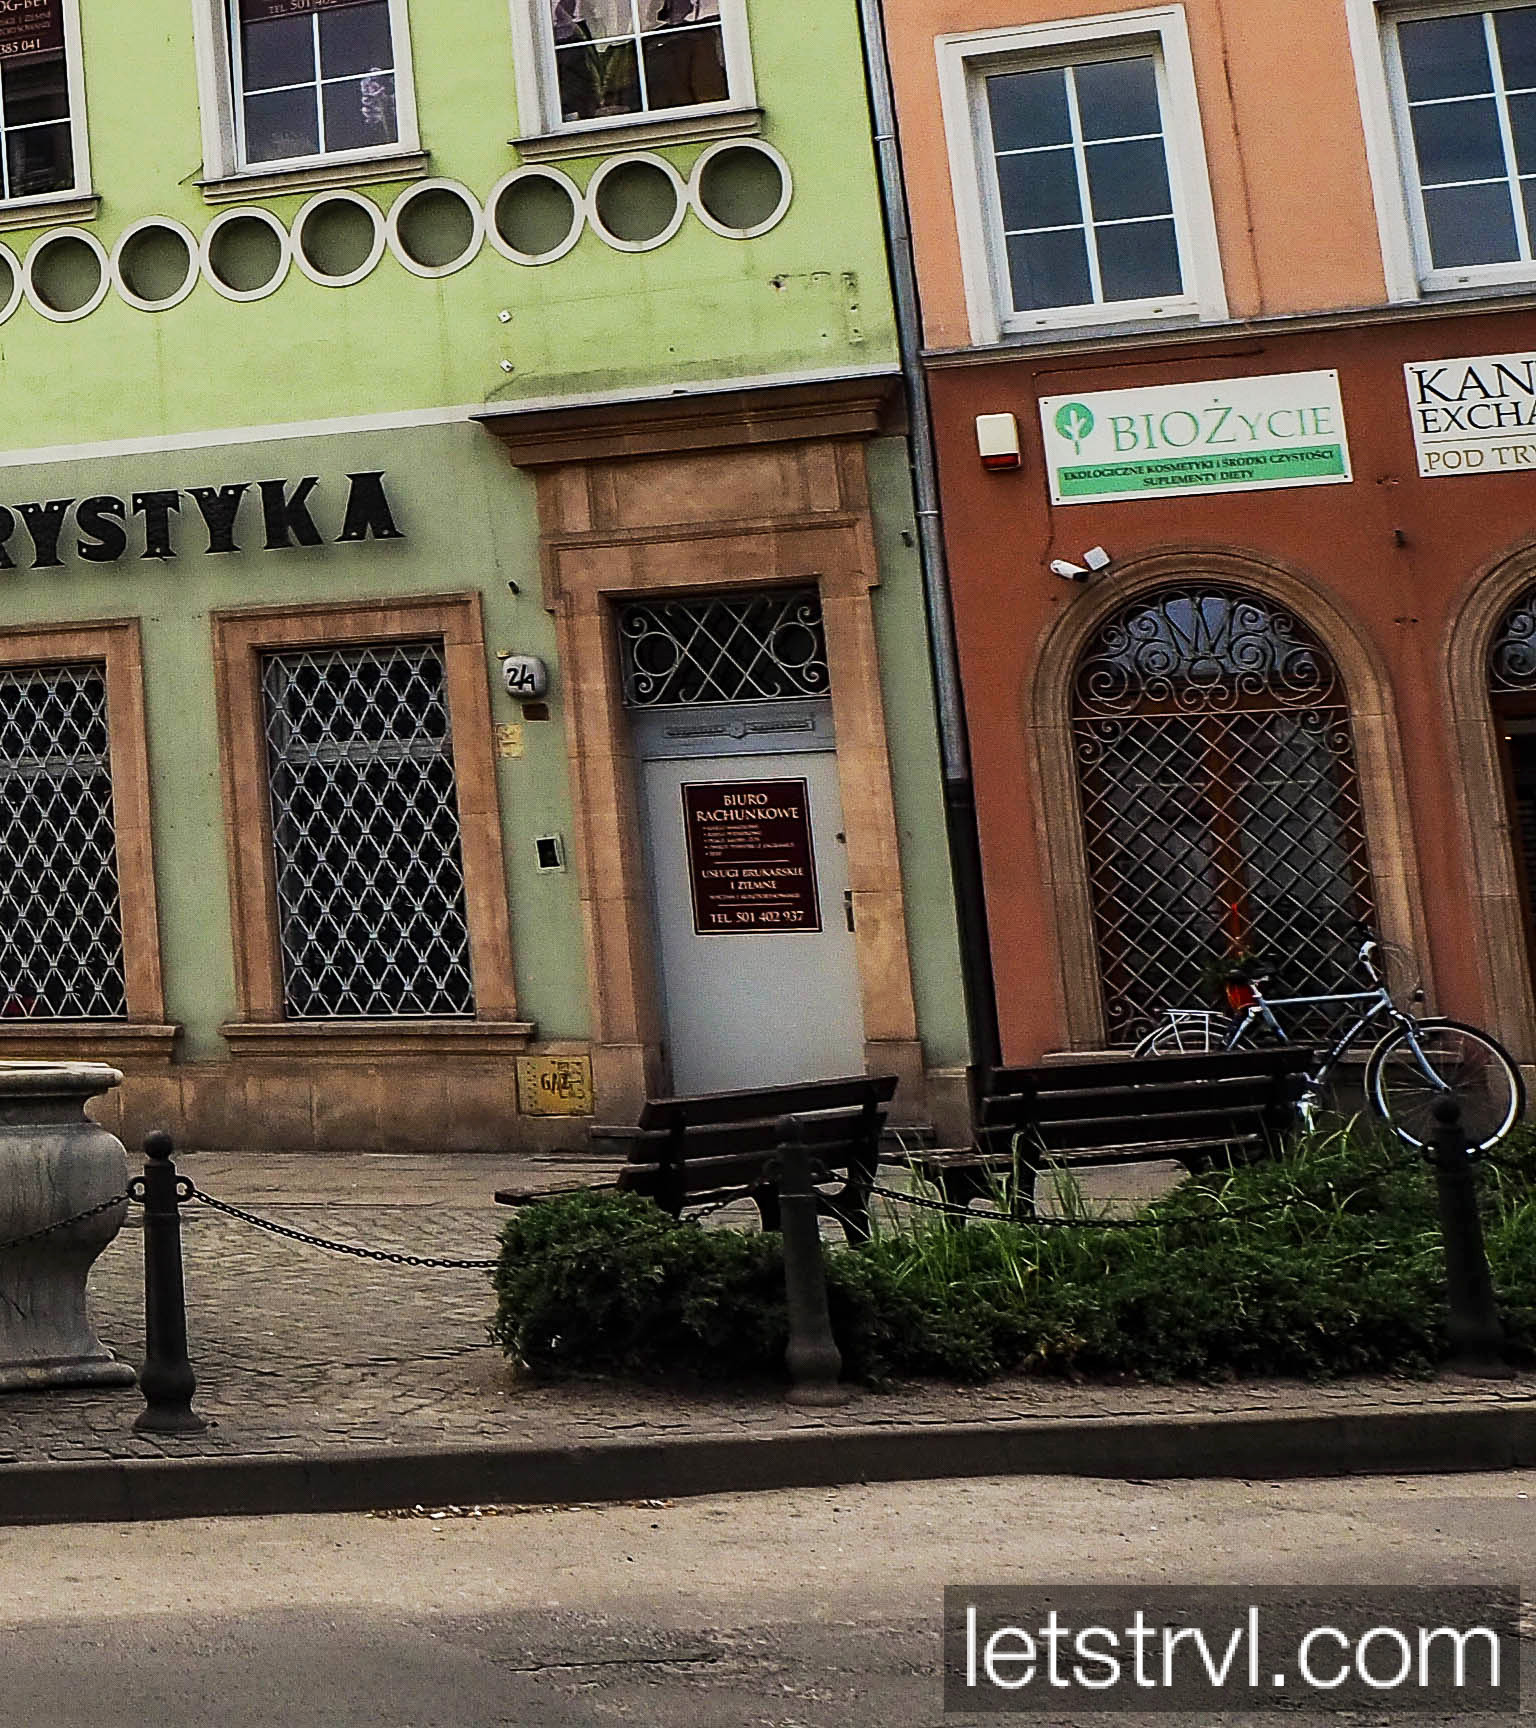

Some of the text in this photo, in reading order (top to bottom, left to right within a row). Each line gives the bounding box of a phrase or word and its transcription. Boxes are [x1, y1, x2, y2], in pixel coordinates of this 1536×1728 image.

[0, 41, 19, 56] 385
[21, 38, 41, 51] 041
[1424, 449, 1484, 470] POD
[1219, 468, 1255, 481] DIETY
[723, 793, 769, 807] BIURO
[696, 807, 800, 822] RACHUNKOWE
[737, 879, 777, 891] ZIEMNE
[736, 912, 755, 923] 501
[758, 911, 781, 922] 402
[783, 910, 805, 922] 937
